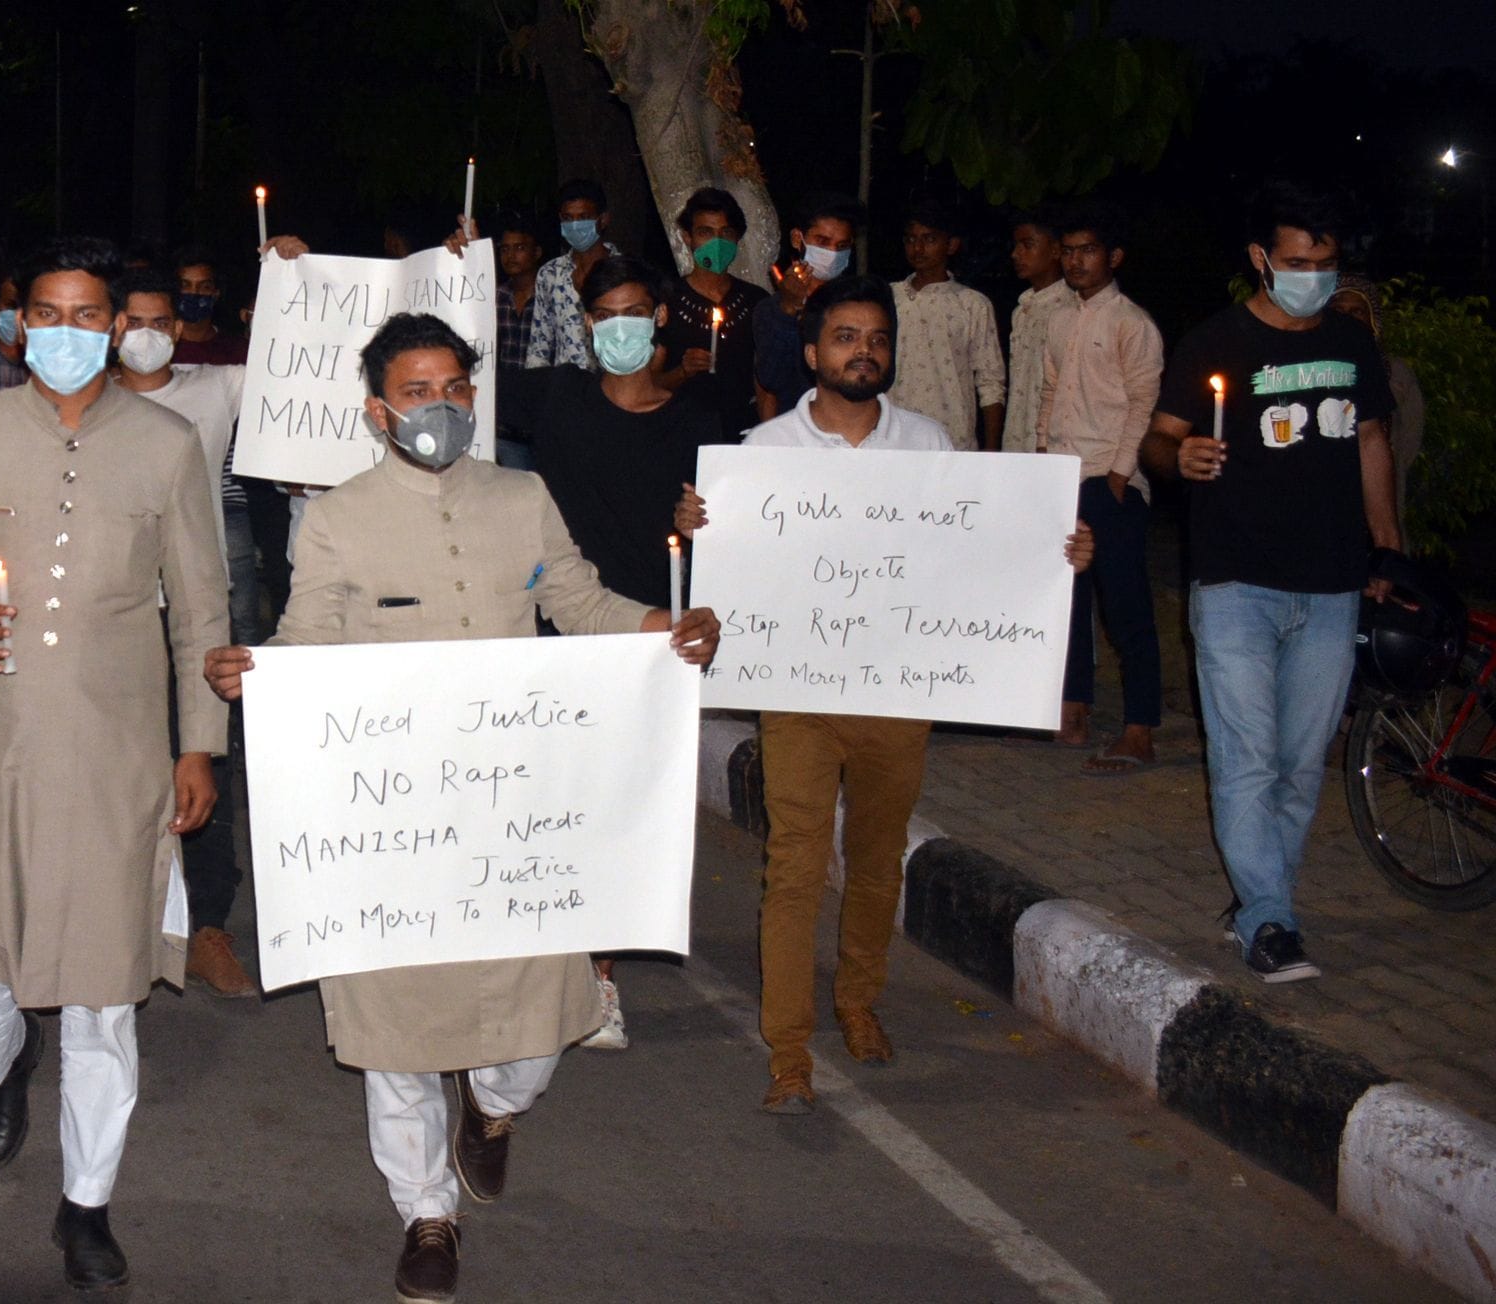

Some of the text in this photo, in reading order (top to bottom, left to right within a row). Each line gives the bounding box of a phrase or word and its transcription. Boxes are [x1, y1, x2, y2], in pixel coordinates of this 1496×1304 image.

[281, 272, 487, 328] AMU STANDS
[258, 395, 386, 441] MANI
[761, 492, 980, 536] Girls are not
[813, 555, 905, 598] Objects
[723, 606, 1045, 647] Stop Rape Terrorism
[790, 662, 847, 695] Mercy
[319, 691, 599, 749] Need Justice
[440, 759, 532, 809] Rape
[279, 811, 586, 873] MANISHA Needs
[469, 856, 581, 887] Justice
[360, 903, 437, 939] Mercy
